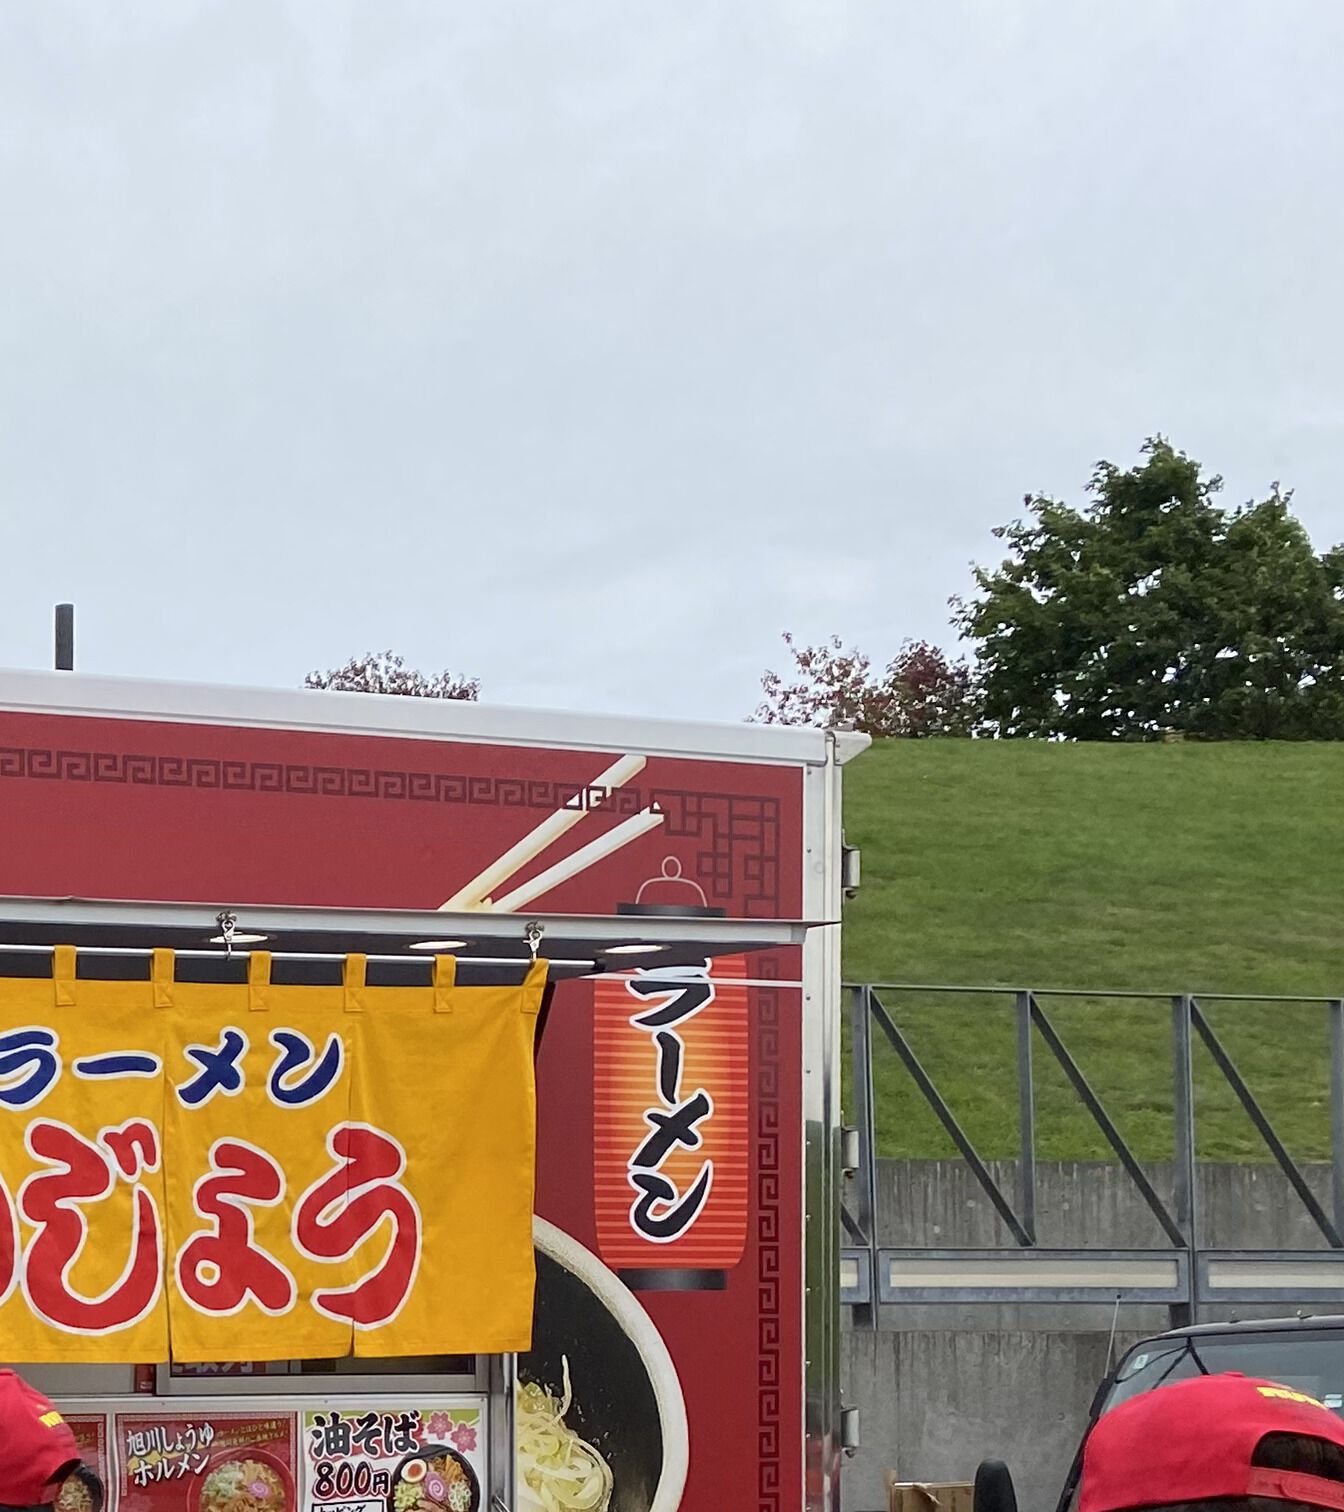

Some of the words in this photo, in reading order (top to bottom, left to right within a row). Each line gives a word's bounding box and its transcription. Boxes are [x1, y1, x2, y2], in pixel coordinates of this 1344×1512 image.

[625, 957, 716, 1244] ラーメン
[125, 1421, 216, 1458] 旭川しょうゆ
[310, 1410, 421, 1458] 油そば
[133, 1451, 211, 1487] ホルメン
[313, 1460, 392, 1499] 800円
